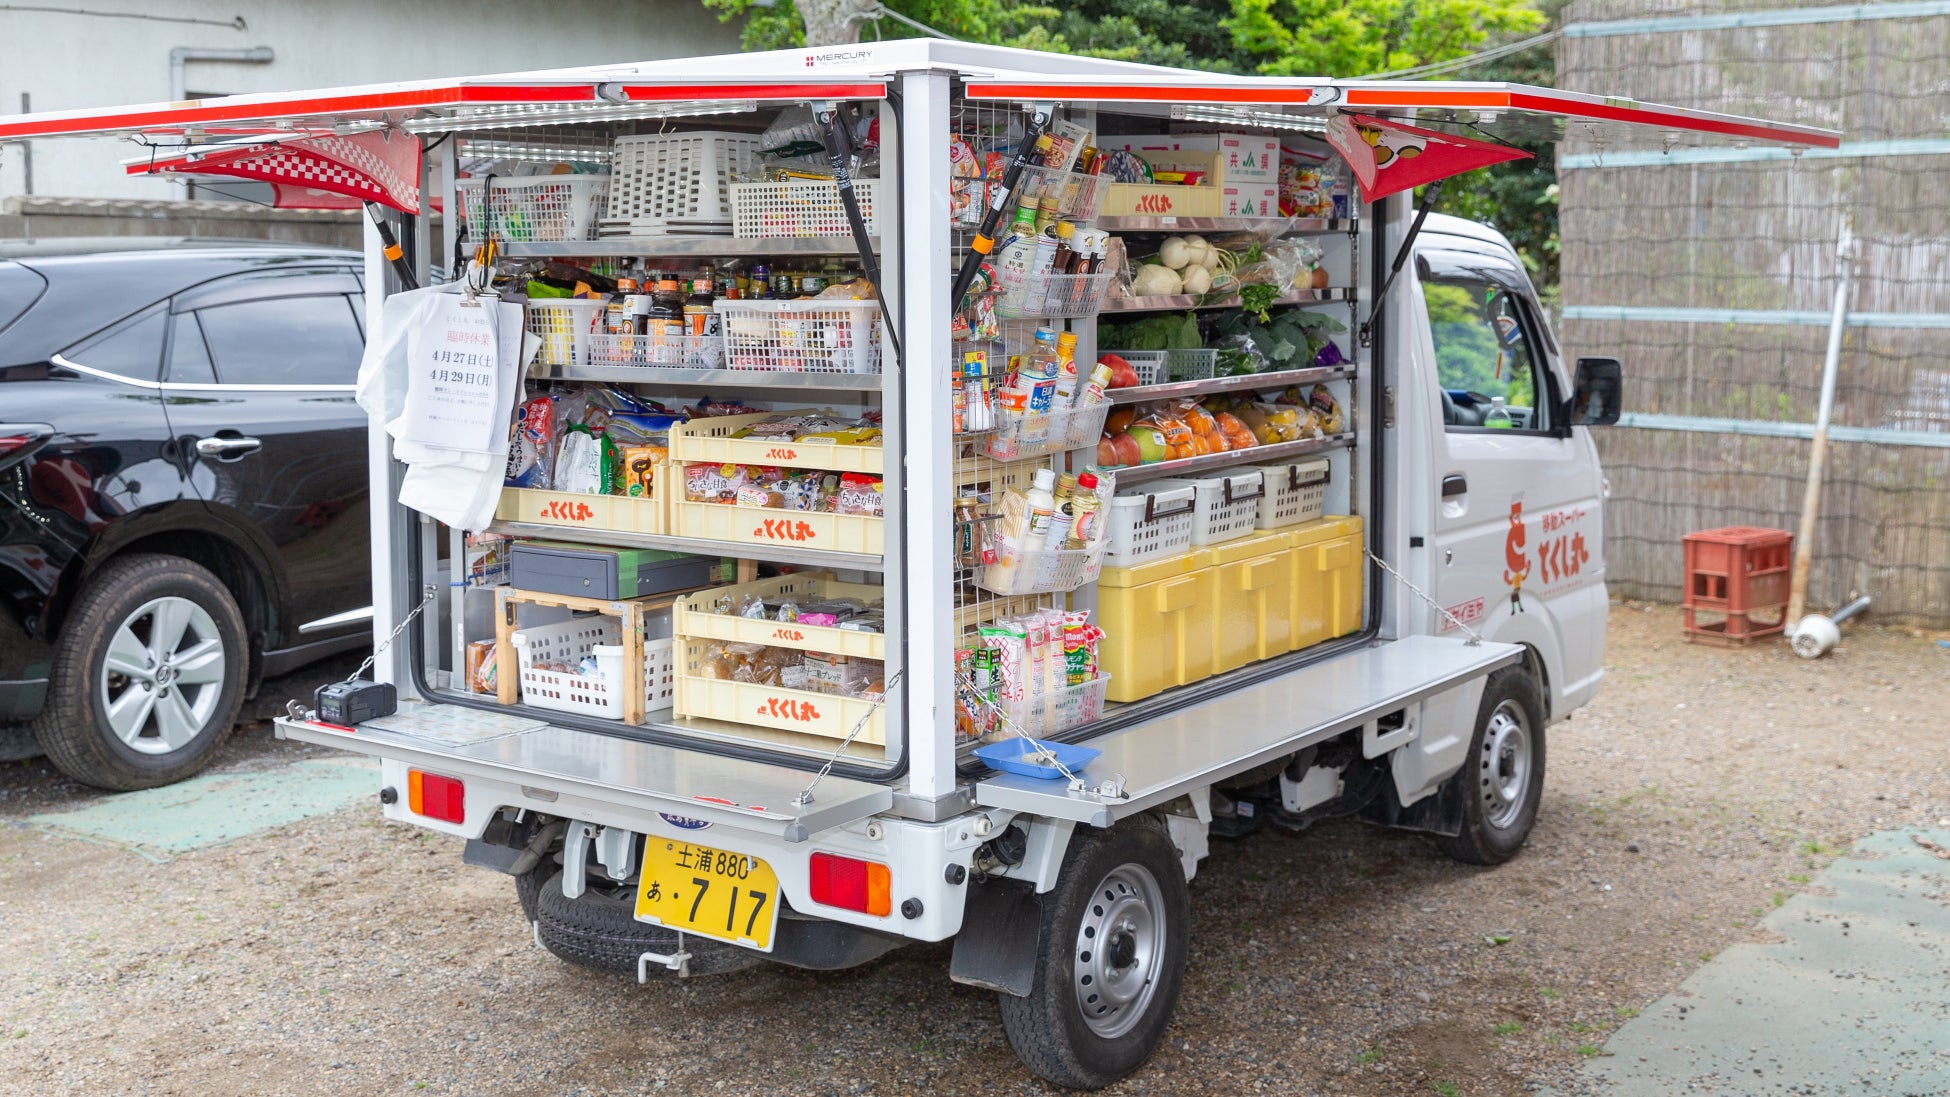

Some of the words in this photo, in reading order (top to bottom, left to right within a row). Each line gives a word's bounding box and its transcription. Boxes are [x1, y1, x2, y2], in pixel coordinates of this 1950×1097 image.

[816, 51, 872, 62] MERCURY
[1141, 194, 1172, 213] とくし丸
[446, 330, 491, 346] 臨時休業
[432, 350, 494, 368] 4月27日(土)
[430, 369, 493, 387] 4月29日(月)
[770, 448, 797, 460] とくし丸
[549, 501, 594, 522] とくし丸
[763, 518, 816, 542] とくし丸
[1538, 531, 1590, 585] とくし丸
[767, 697, 821, 722] とくし丸
[675, 844, 713, 873] 土浦
[715, 852, 749, 880] 880
[646, 880, 662, 903] あ
